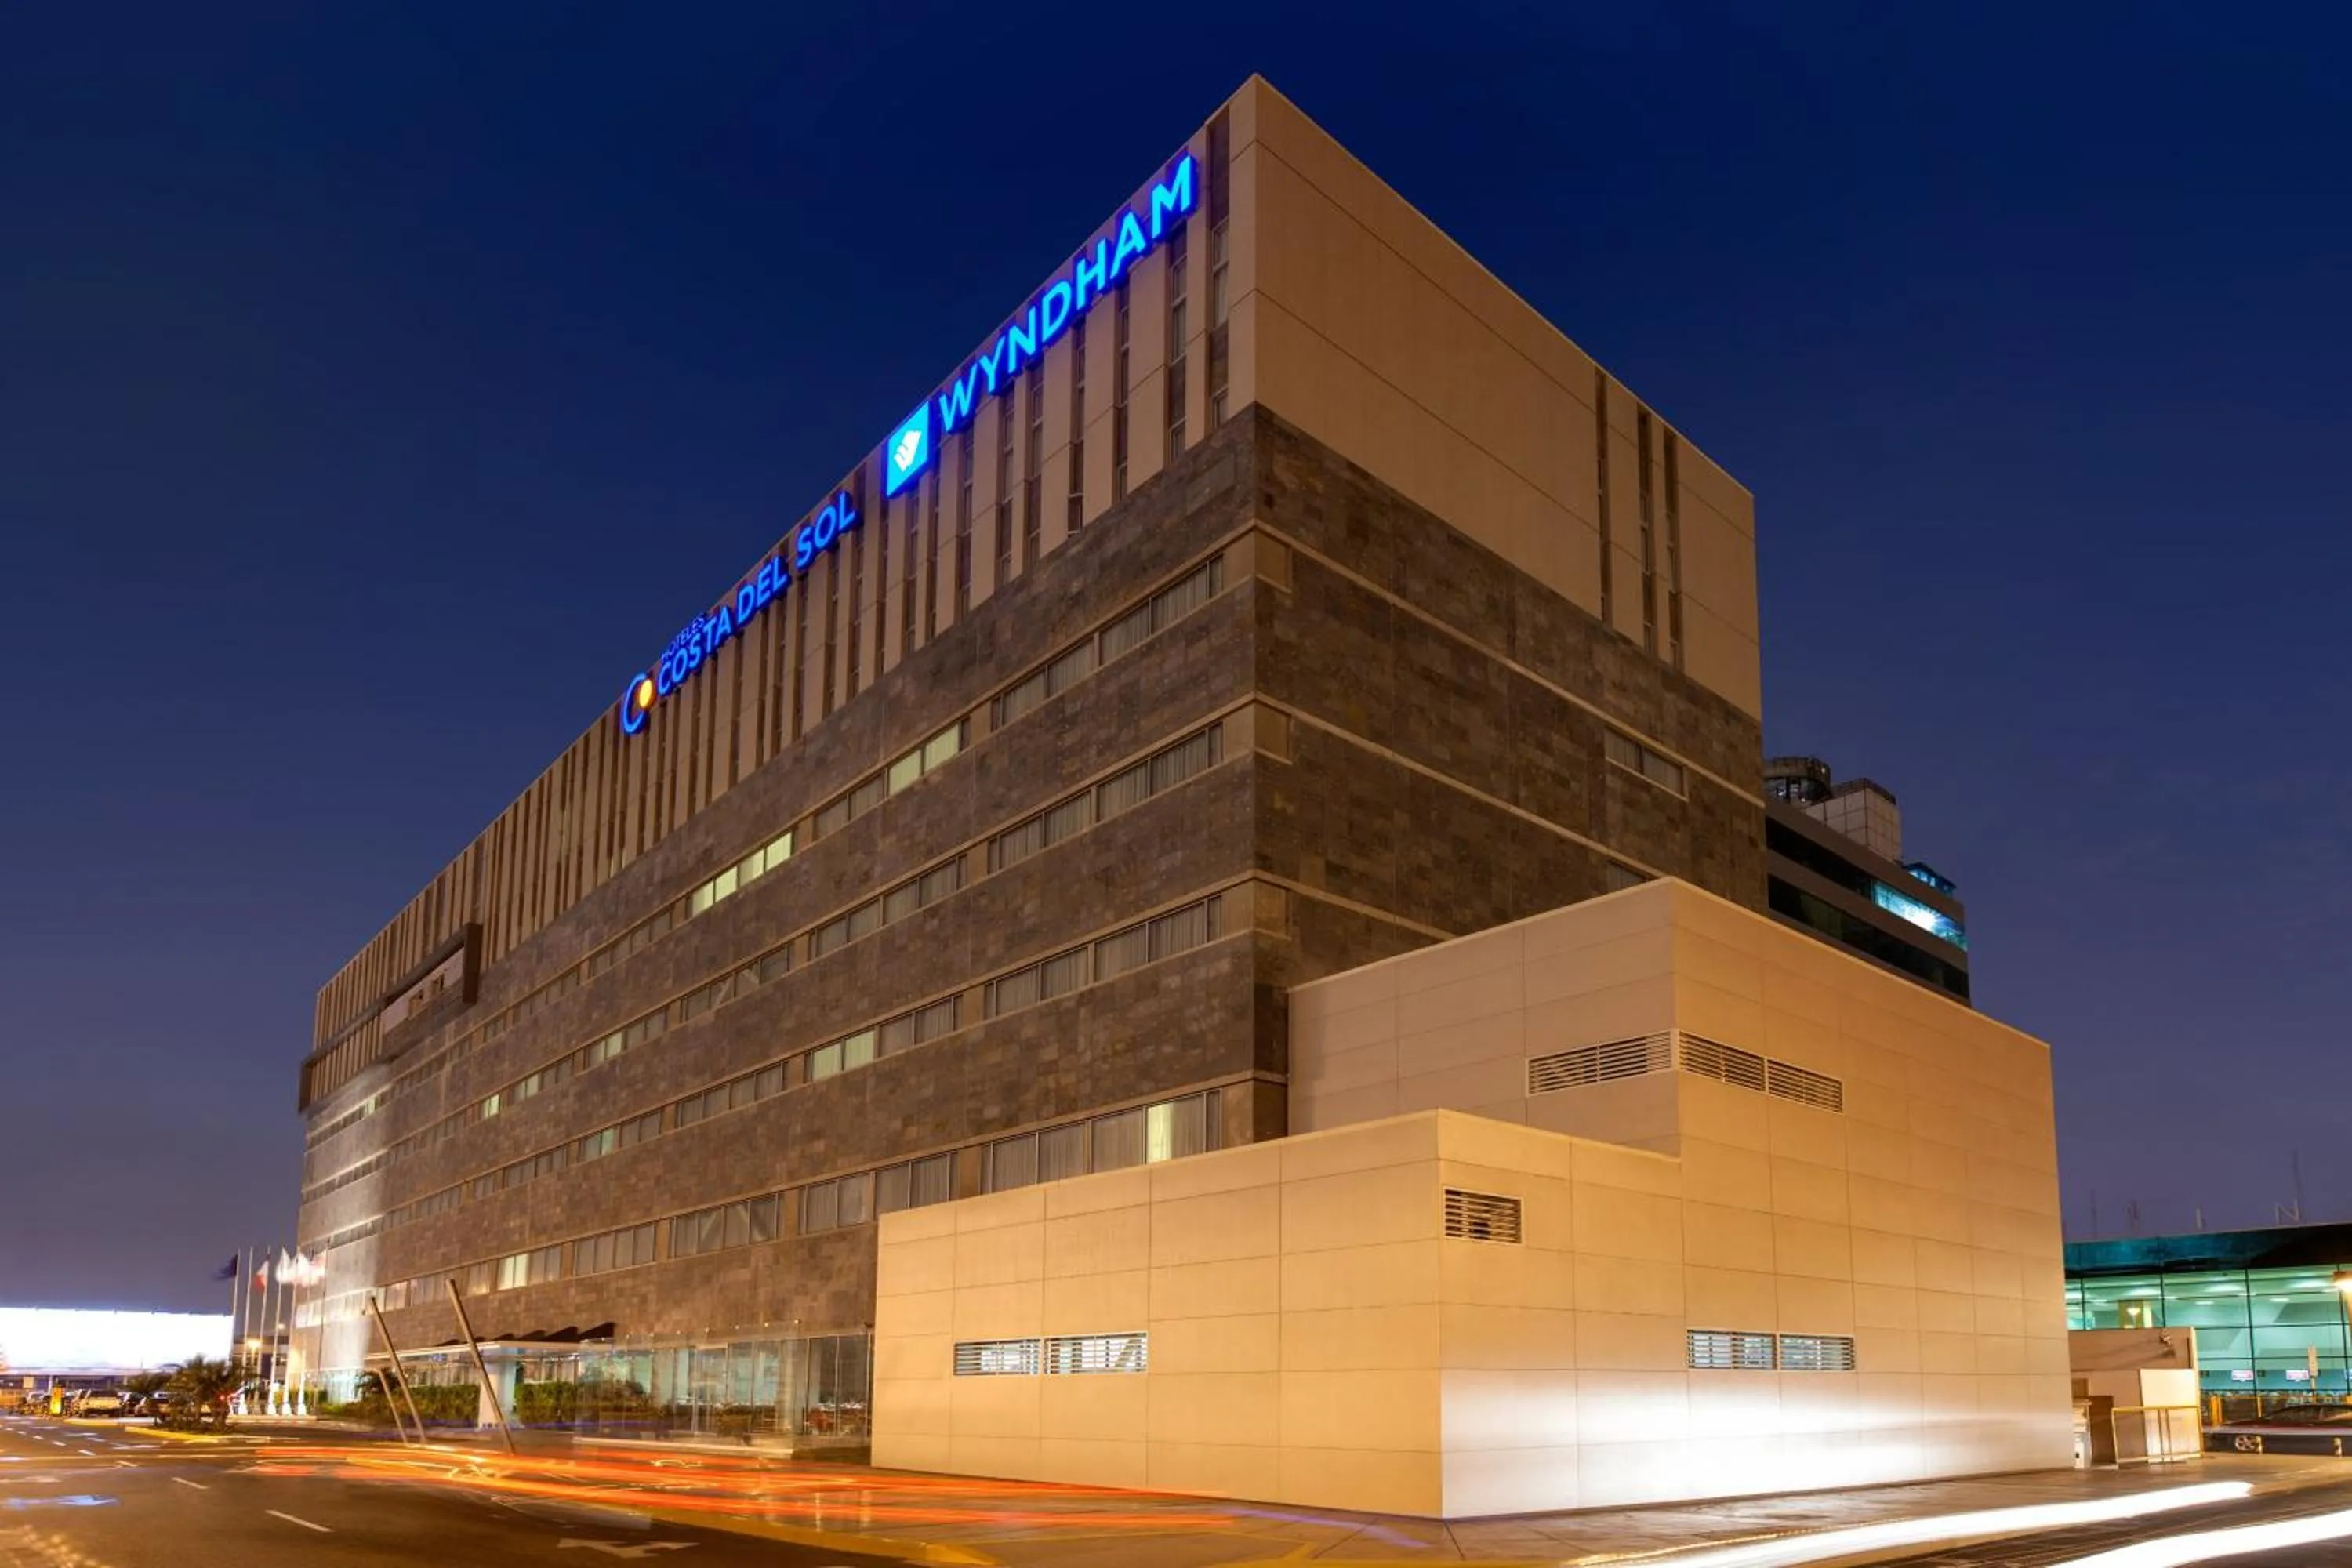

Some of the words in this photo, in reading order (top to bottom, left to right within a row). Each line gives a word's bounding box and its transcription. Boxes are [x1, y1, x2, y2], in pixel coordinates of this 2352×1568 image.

[938, 154, 1192, 431] WYNDHAM
[656, 604, 733, 696] COSTA
[736, 554, 789, 626] DEL
[795, 491, 856, 569] SOL
